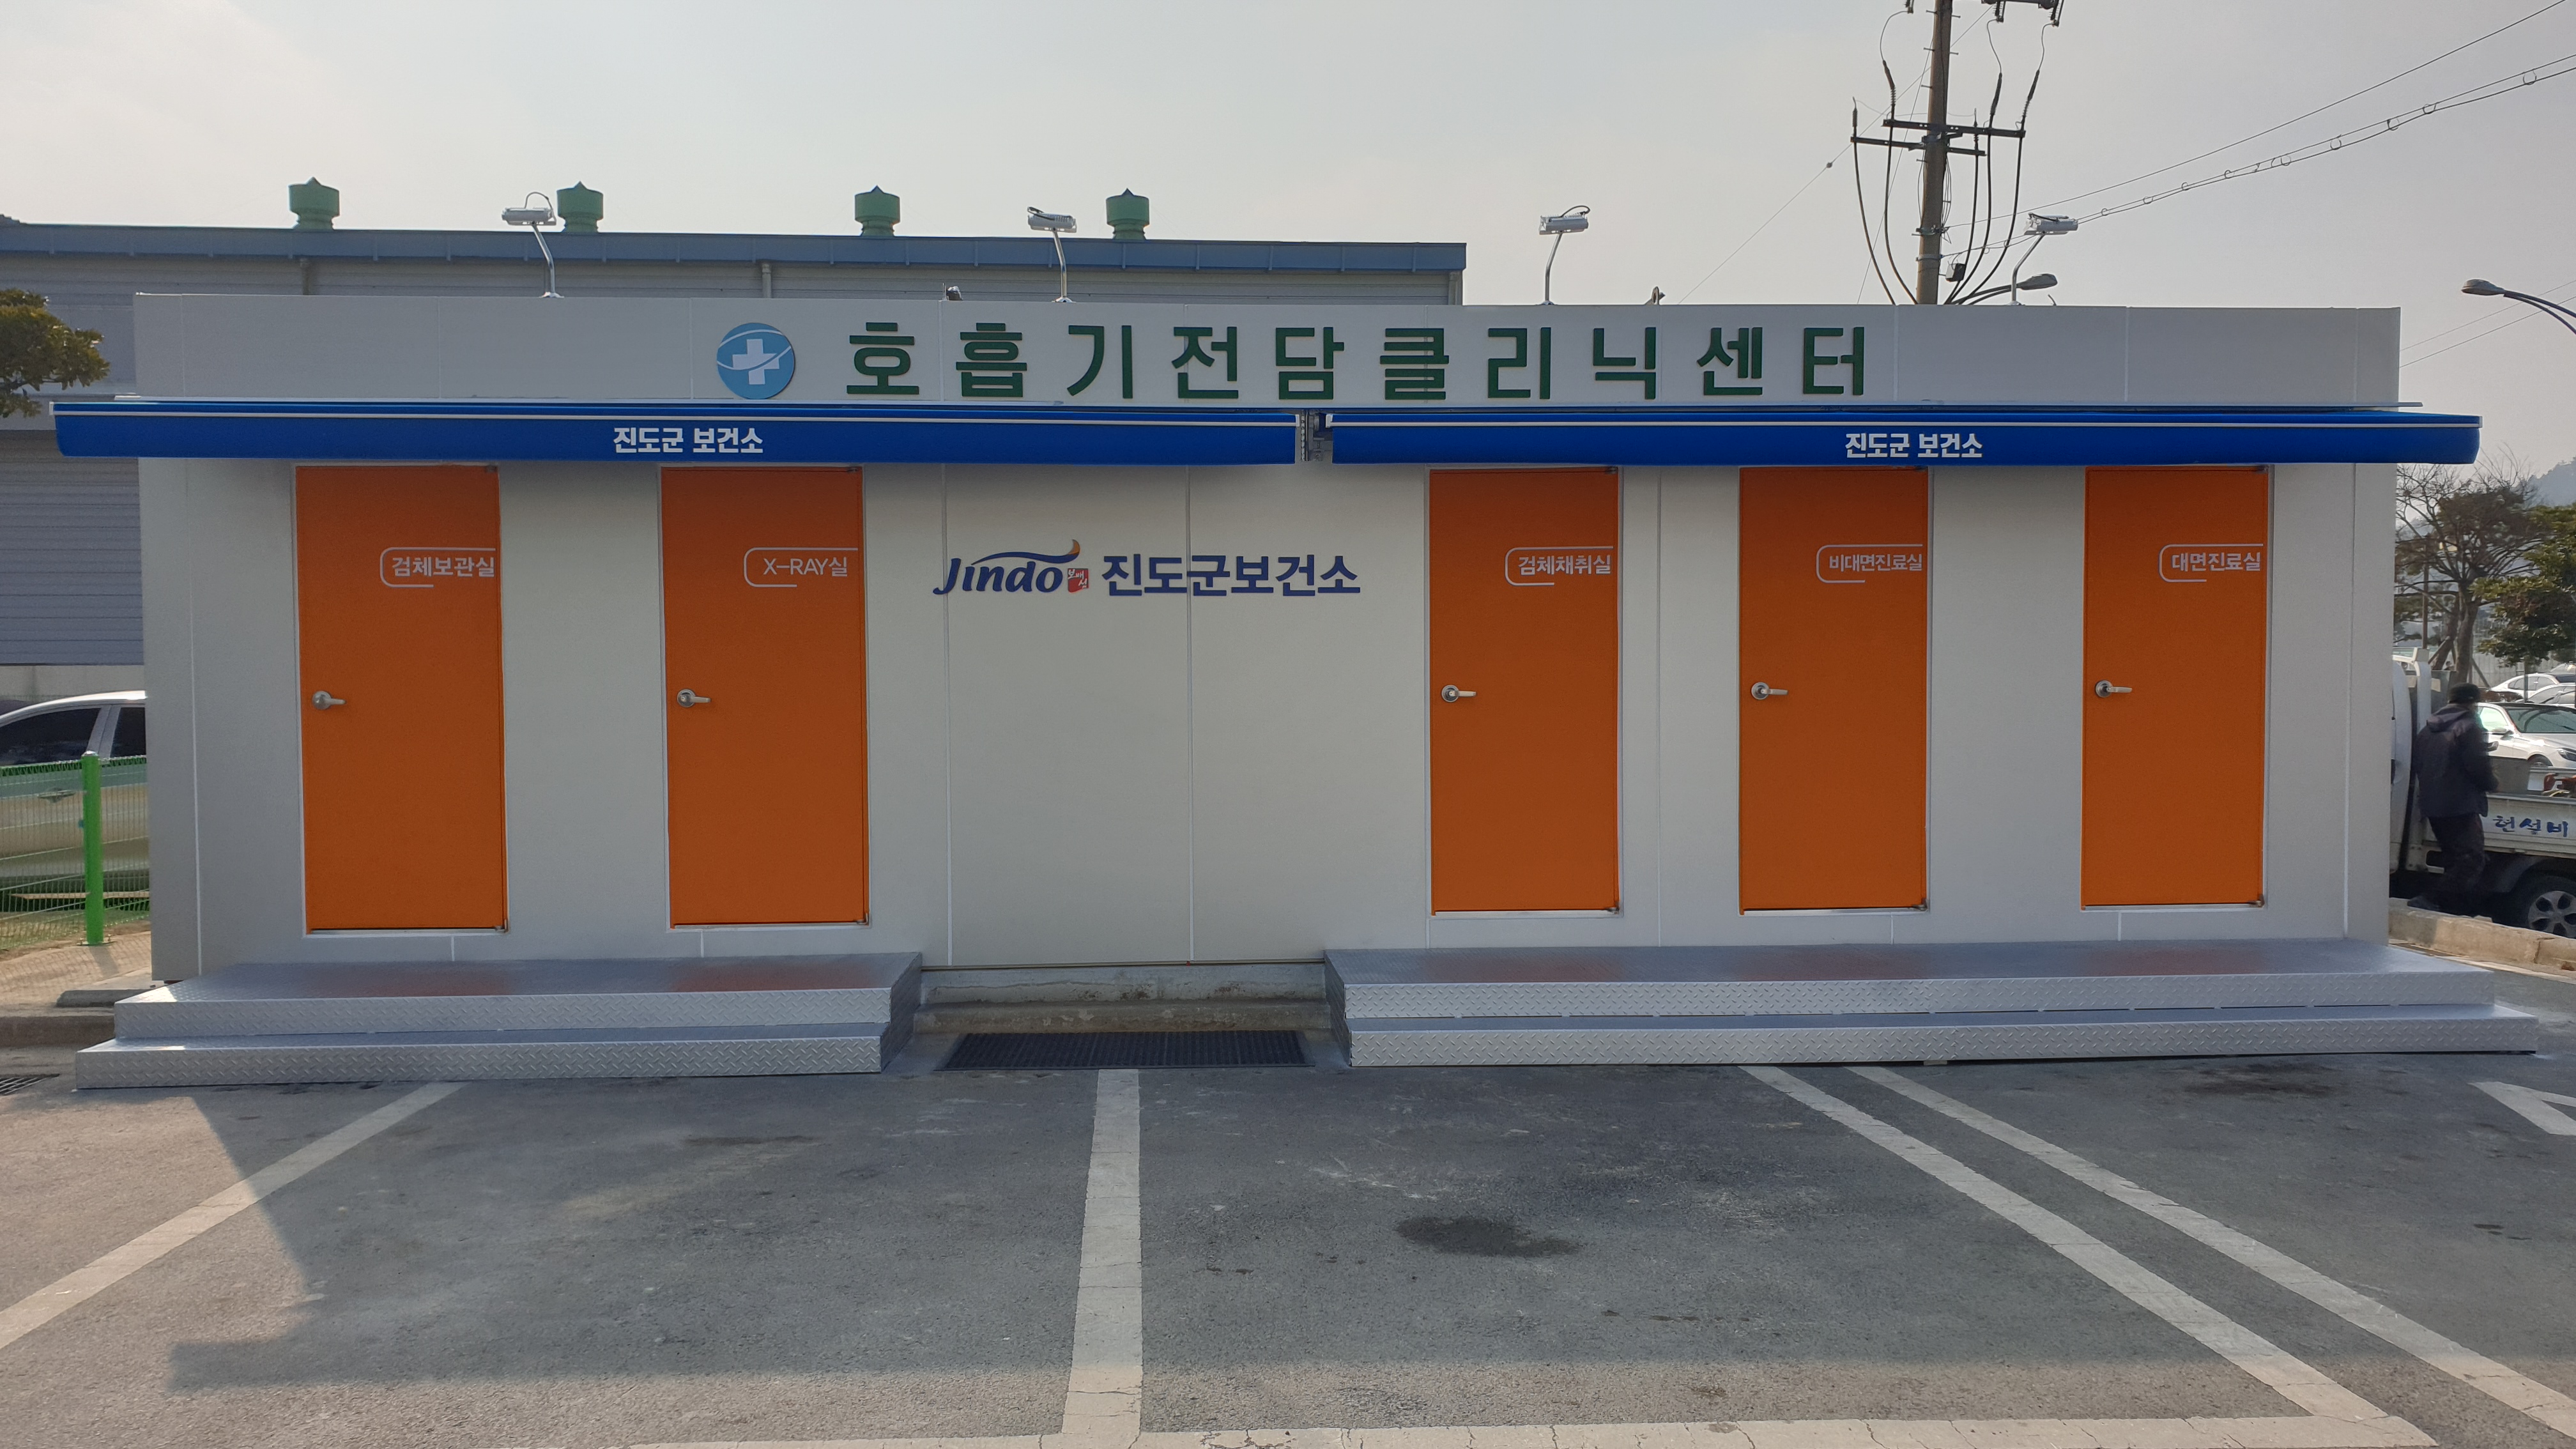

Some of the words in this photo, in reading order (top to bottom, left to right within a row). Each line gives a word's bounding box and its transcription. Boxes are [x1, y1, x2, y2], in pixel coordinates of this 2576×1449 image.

[847, 322, 1865, 399] 호흡기전담클리닉센터
[613, 427, 684, 453] 진도군
[693, 428, 763, 453] 보건소
[1845, 433, 1910, 458] 진도군
[1917, 433, 1982, 458] 보건소
[392, 556, 495, 578] 검체보관실
[763, 556, 848, 578] X-RAY실
[1517, 555, 1611, 576] 검체채취실
[1828, 553, 1923, 572] 비대면진료실
[2172, 551, 2262, 572] 대면진료실
[933, 557, 1064, 595] Jindo
[1101, 554, 1361, 597] 진도군보건소
